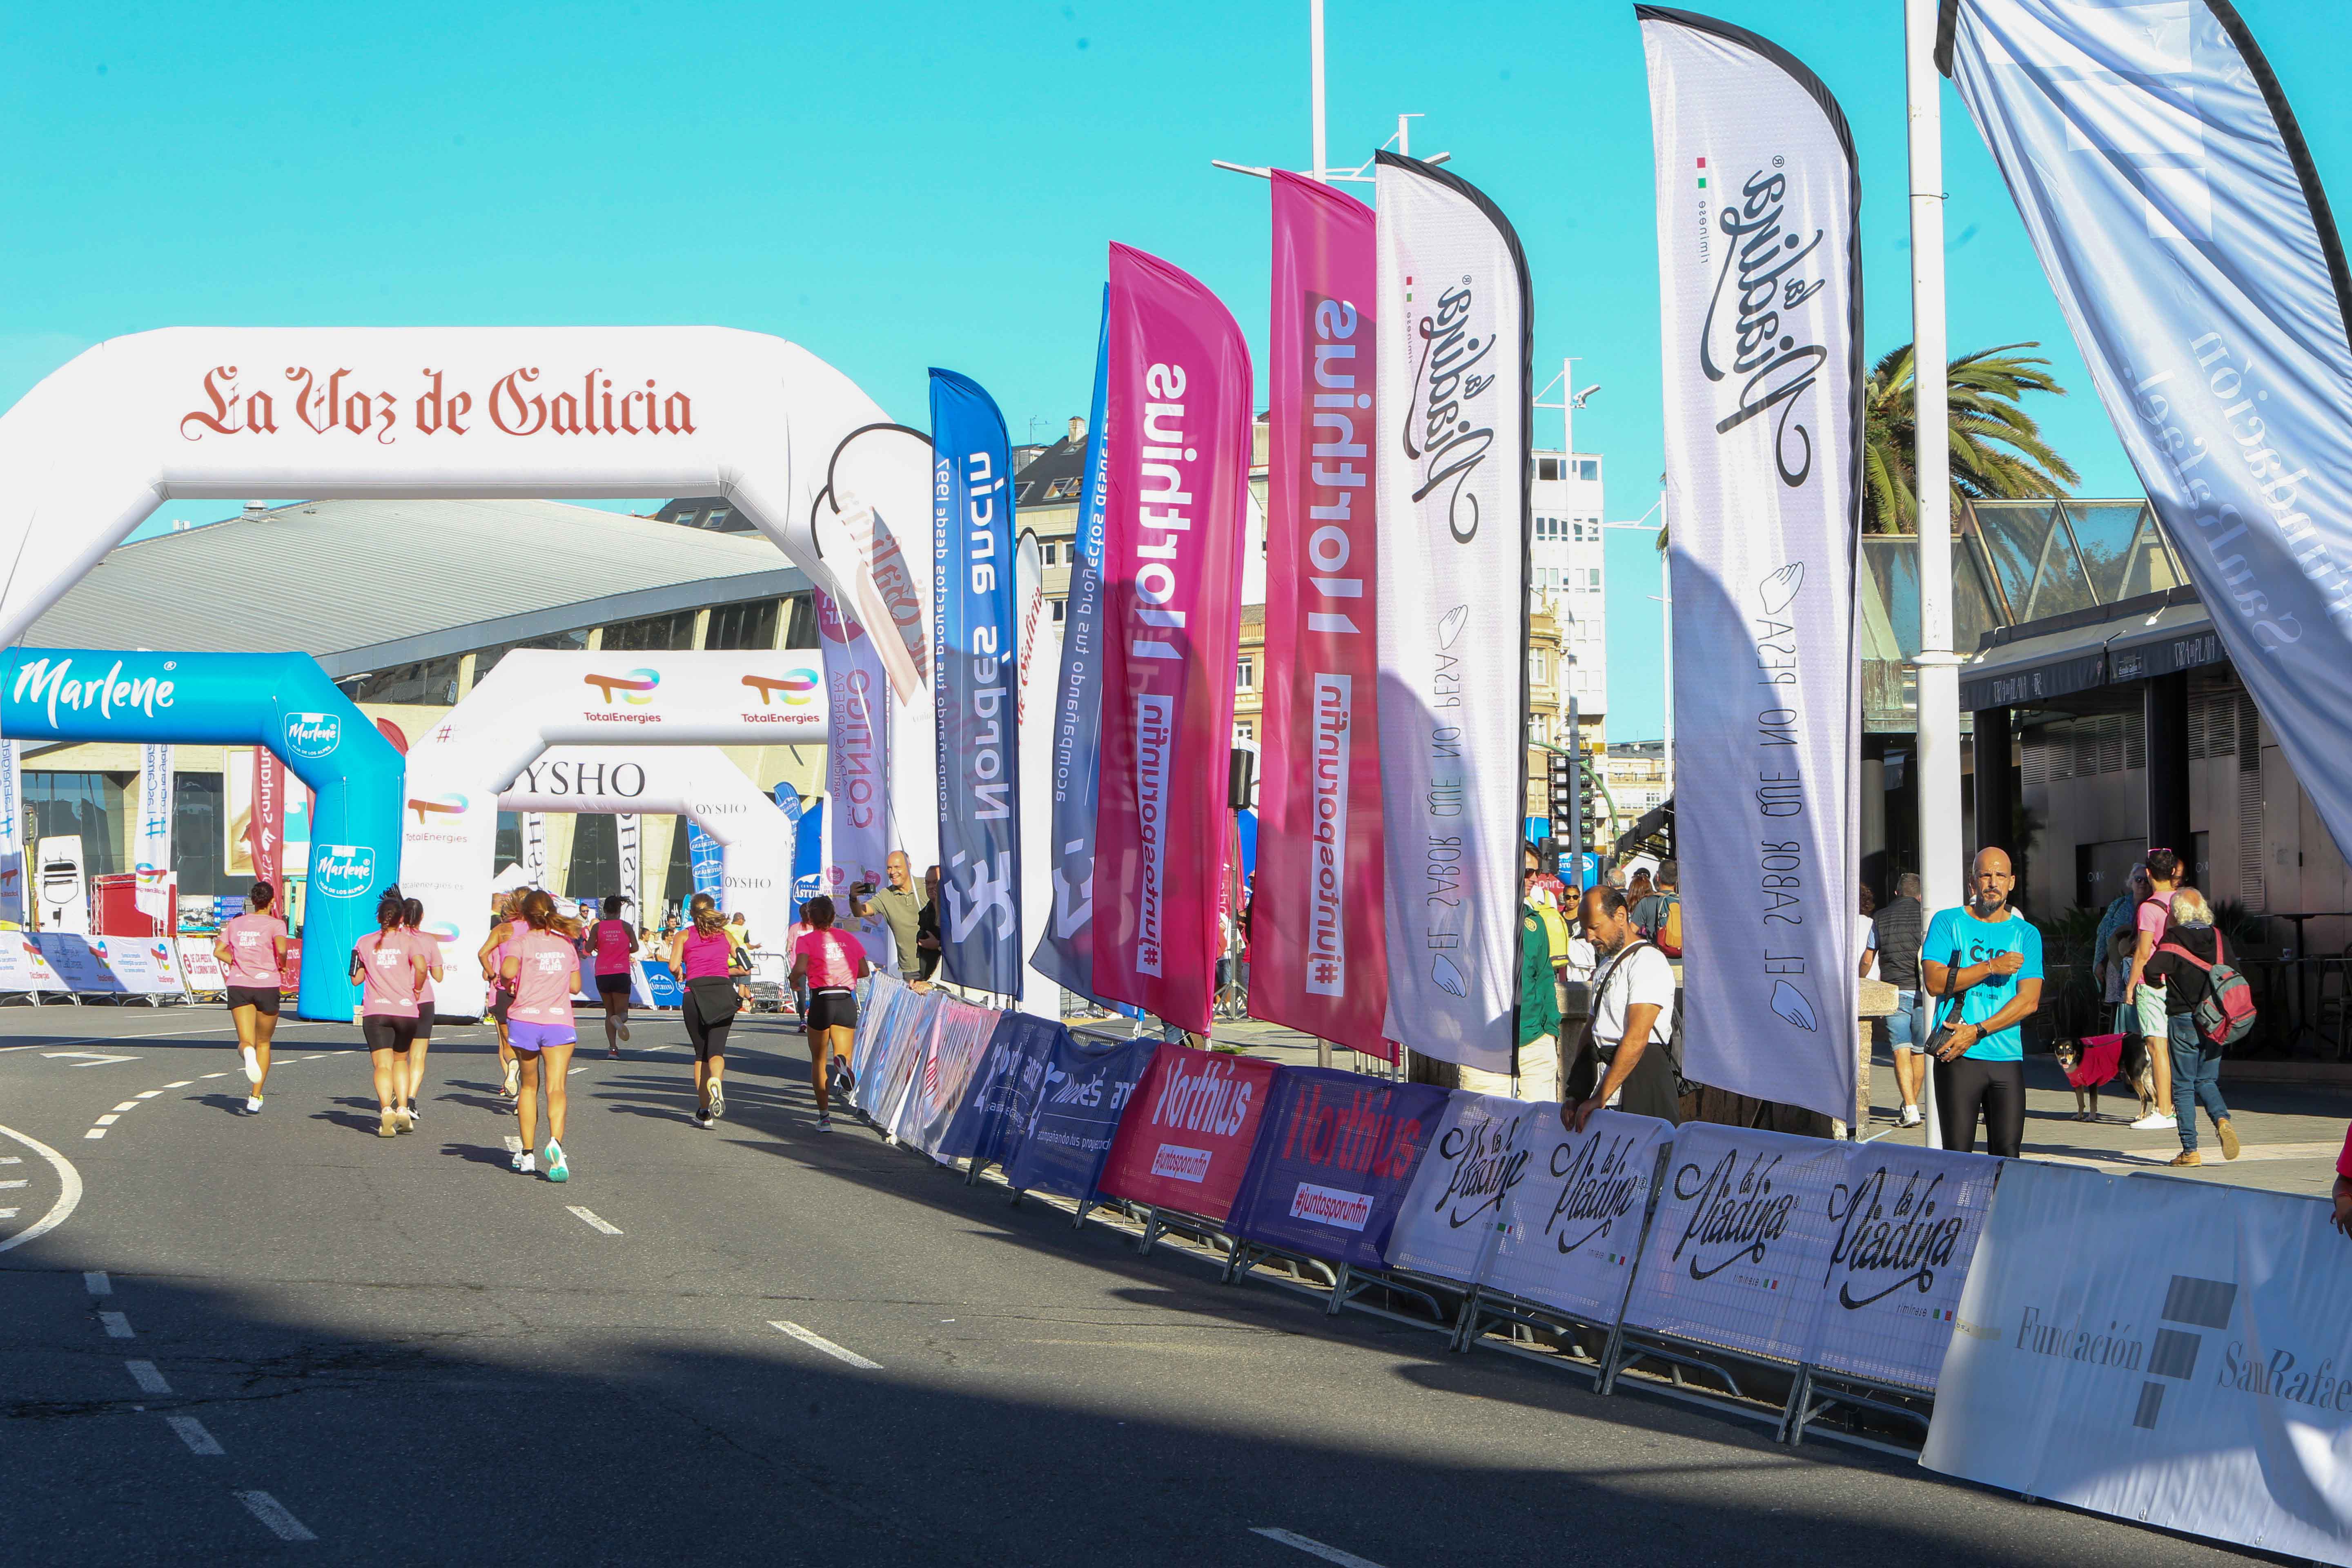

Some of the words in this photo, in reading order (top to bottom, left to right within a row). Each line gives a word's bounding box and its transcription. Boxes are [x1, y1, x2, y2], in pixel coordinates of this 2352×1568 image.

[180, 365, 279, 441] La
[284, 365, 398, 445] Voz
[415, 367, 472, 437] de
[488, 366, 698, 437] Galicia
[13, 657, 175, 729] Marlene
[584, 712, 662, 724] TotalEnergies
[741, 713, 820, 725] TotalEnergies
[289, 723, 336, 746] Marlene
[317, 745, 332, 755] ALPES
[696, 804, 747, 815] OYSHO
[406, 832, 468, 844] TotalEnergies
[318, 856, 370, 883] Marlene
[725, 876, 771, 889] OYSHO
[347, 884, 365, 894] ALPES
[1152, 1058, 1253, 1137] Northius
[1281, 1084, 1422, 1180] Northius
[1156, 1147, 1208, 1180] #juntosporunfin
[1295, 1187, 1369, 1225] #juntosporunfin
[1672, 1149, 1793, 1281] Piadina
[1823, 1166, 1962, 1310] Piadina
[1733, 1273, 1760, 1287] riminese
[1897, 1304, 1927, 1317] riminese
[2014, 1305, 2143, 1371] Fundación
[2217, 1340, 2352, 1412] SanRafae
